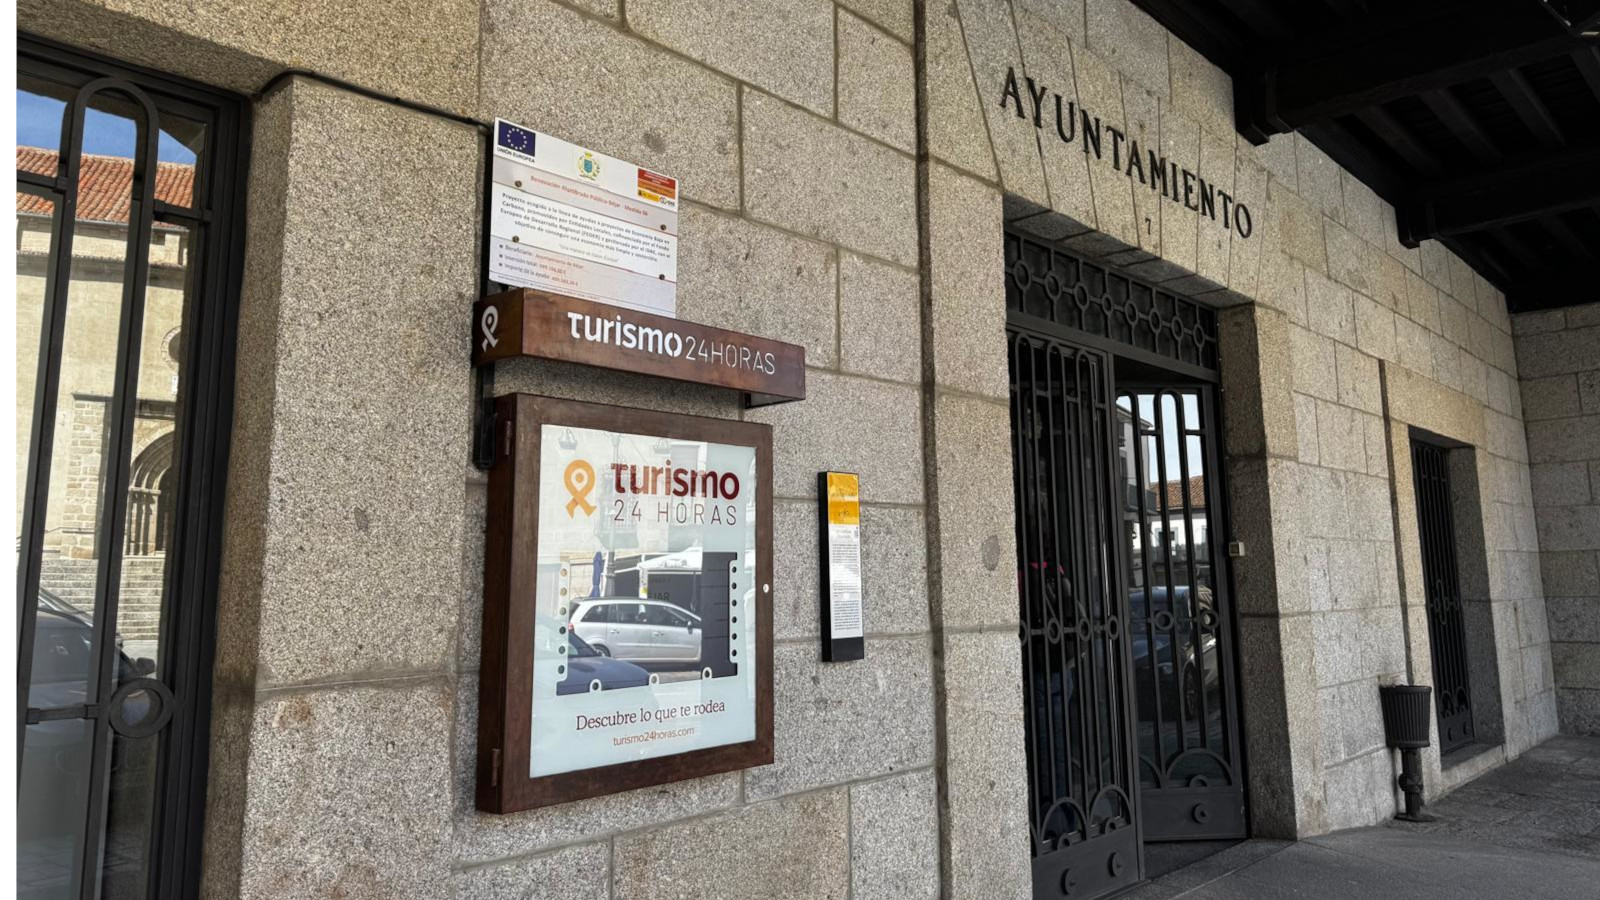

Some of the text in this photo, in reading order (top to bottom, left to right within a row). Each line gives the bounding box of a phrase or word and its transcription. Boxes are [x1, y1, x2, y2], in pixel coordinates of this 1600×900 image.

[497, 146, 535, 163] UNIÓN EUROPEA
[999, 66, 1252, 239] AYUNTAMIENTO
[531, 175, 560, 189] Renovación
[500, 208, 522, 219] Europeo
[531, 216, 558, 228] Desarrollo
[559, 224, 580, 235] Regional
[502, 192, 525, 205] Proyecto
[527, 200, 547, 211] acogido
[558, 209, 570, 217] línea
[580, 215, 596, 225] ayudas
[601, 221, 624, 233] proyectos
[632, 230, 653, 240] Economía
[502, 200, 526, 213] Carbono,
[527, 208, 557, 221] promovidos
[569, 219, 592, 230] Entidades
[593, 226, 612, 236] Locales,
[656, 243, 669, 251] Fondo
[1145, 217, 1151, 235] 7
[515, 219, 536, 231] objetivo
[545, 228, 569, 240] conseguir
[581, 238, 604, 248] economía
[616, 247, 630, 256] limpia
[505, 255, 525, 265] Inversión
[505, 263, 523, 273] Importe
[567, 311, 775, 375] turismo 24HORAS
[610, 459, 740, 500] turismo
[614, 499, 737, 526] 24 HORAS
[576, 700, 725, 730] Descubre lo que te rodea
[613, 726, 695, 746] turismo24horas.com
